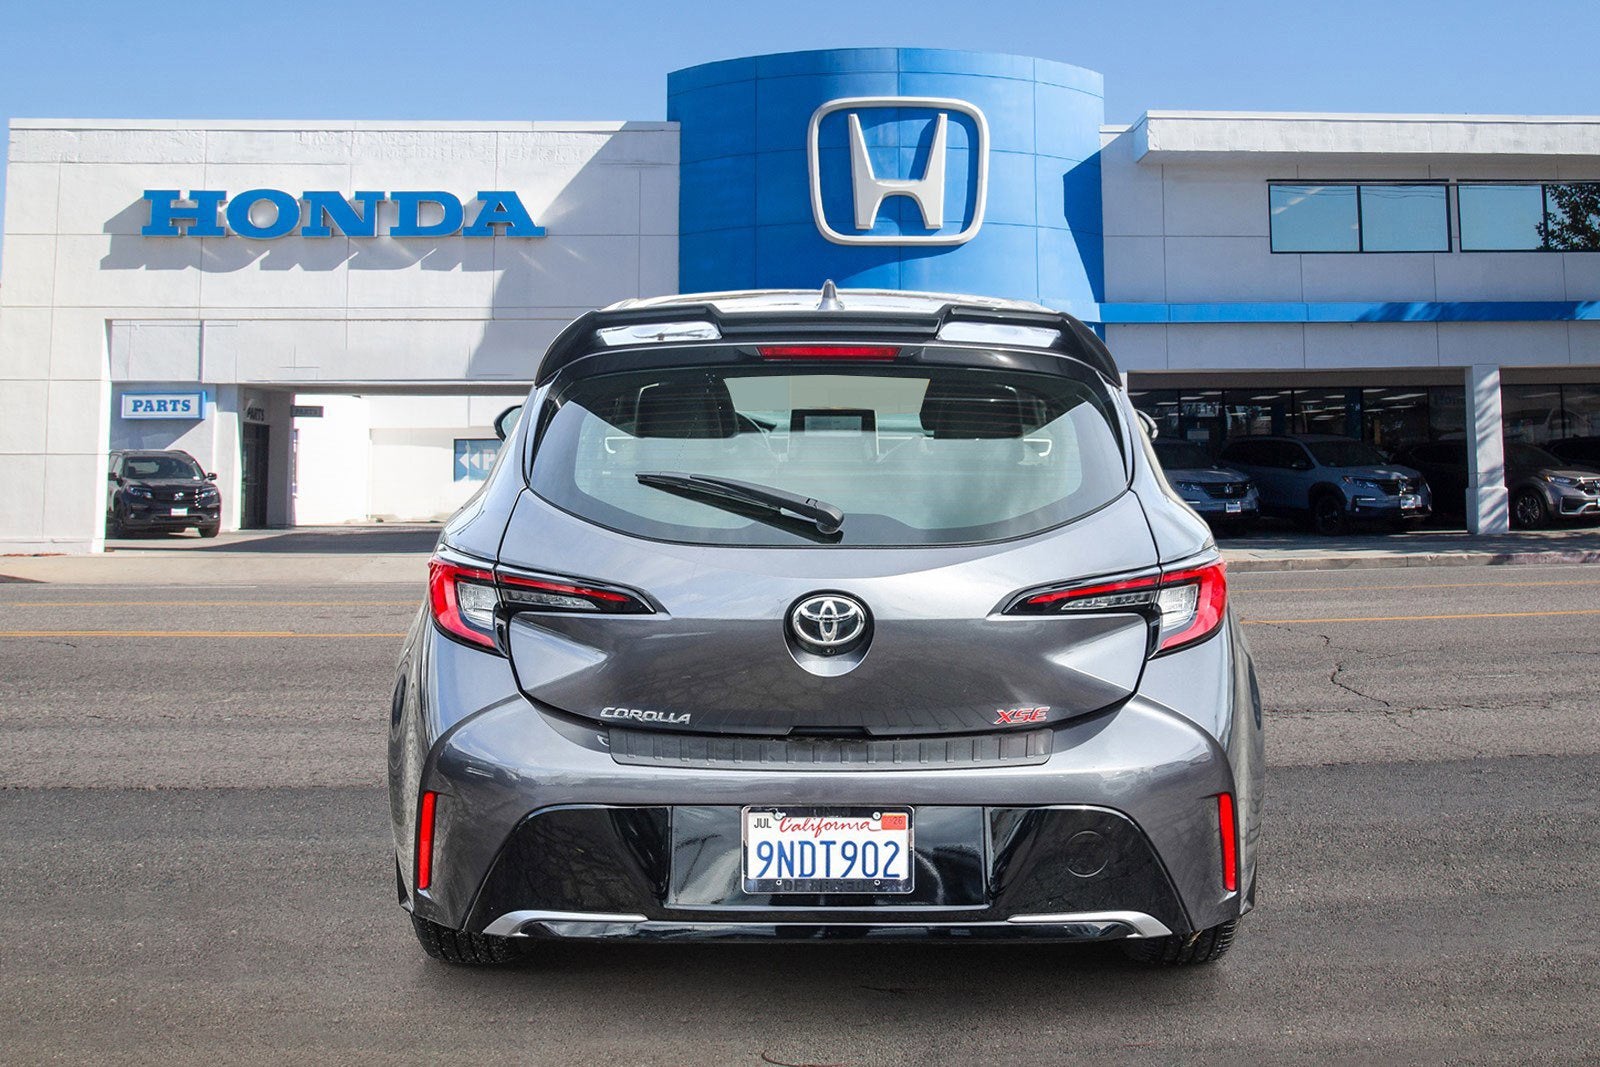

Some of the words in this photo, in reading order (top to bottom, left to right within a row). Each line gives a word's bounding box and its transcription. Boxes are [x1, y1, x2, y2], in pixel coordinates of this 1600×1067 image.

[141, 188, 547, 240] HONDA
[132, 399, 191, 412] PARTS
[600, 706, 691, 725] COROLLA
[993, 706, 1050, 725] XSE
[754, 818, 772, 829] JUL
[779, 817, 881, 838] California
[756, 840, 900, 878] 9NDT902
